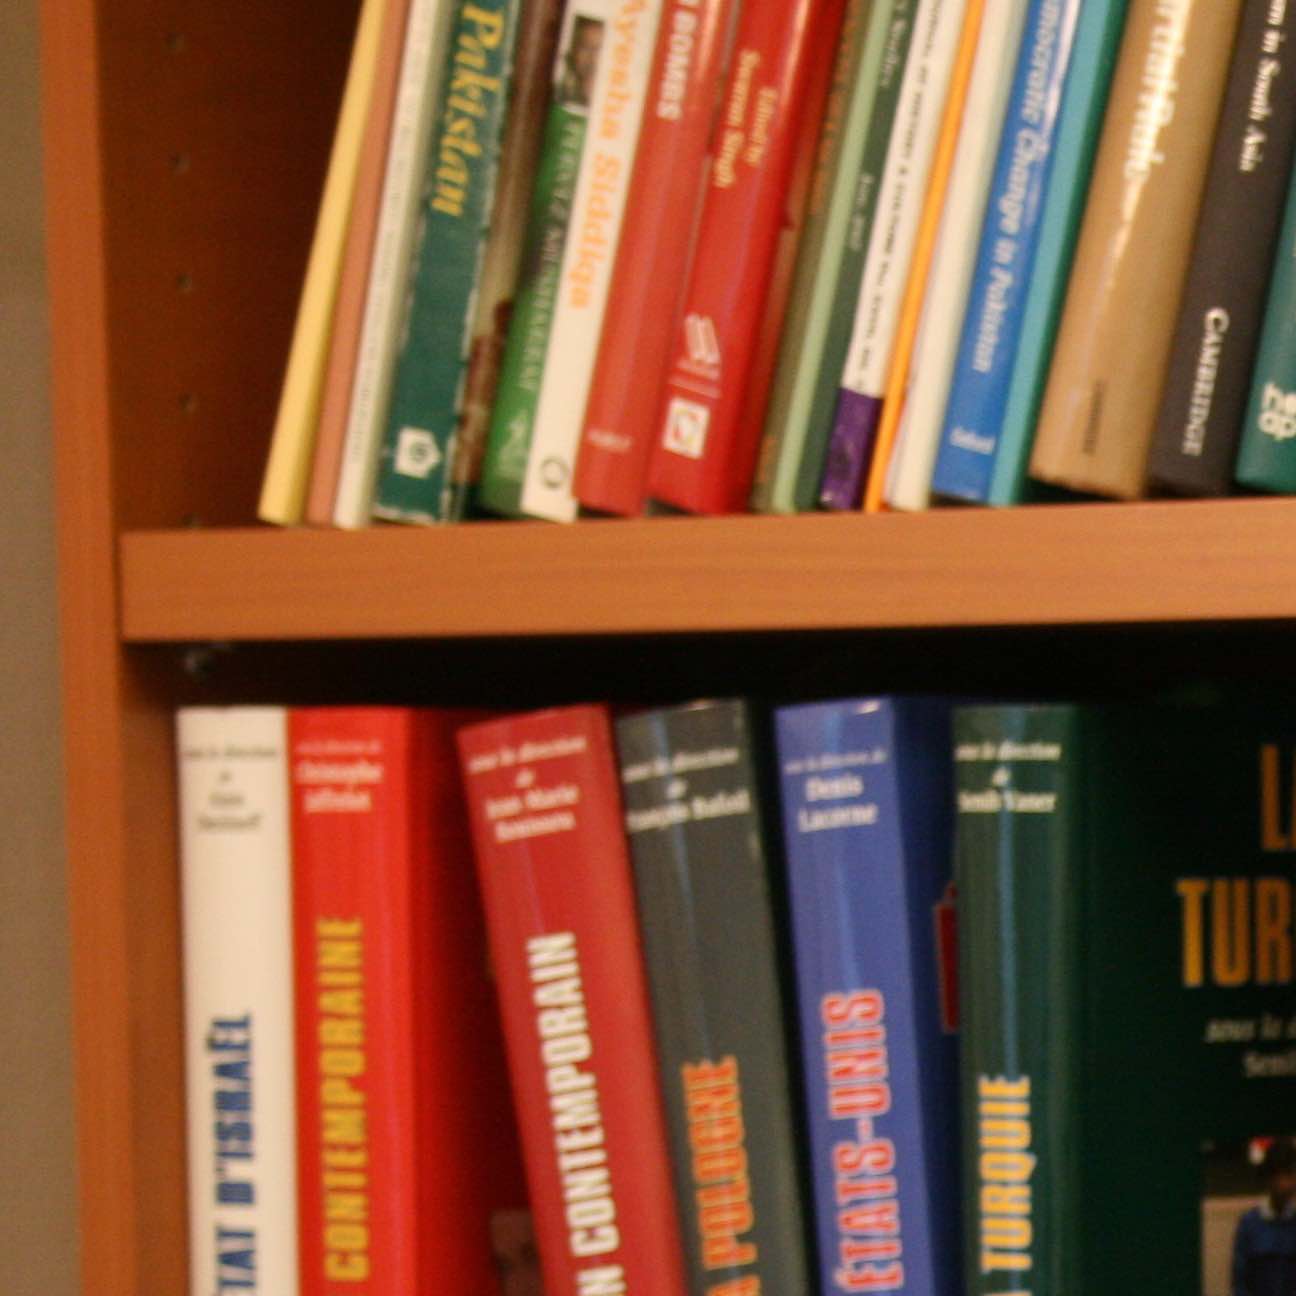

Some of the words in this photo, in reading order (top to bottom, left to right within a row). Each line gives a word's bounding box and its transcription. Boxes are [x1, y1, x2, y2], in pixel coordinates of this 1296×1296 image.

[430, 4, 503, 217] Pakistan
[997, 126, 1050, 235] Change
[1236, 123, 1268, 173] Asia
[1249, 58, 1281, 122] South
[971, 265, 1016, 373] Pakistan
[315, 916, 370, 1283] CONTEMPORAINE
[526, 931, 621, 1258] CONTEMPORAIN
[681, 1054, 759, 1271] POLOGNE
[820, 988, 906, 1293] ÉTATS-UNIS
[977, 1072, 1038, 1273] TURQUIE
